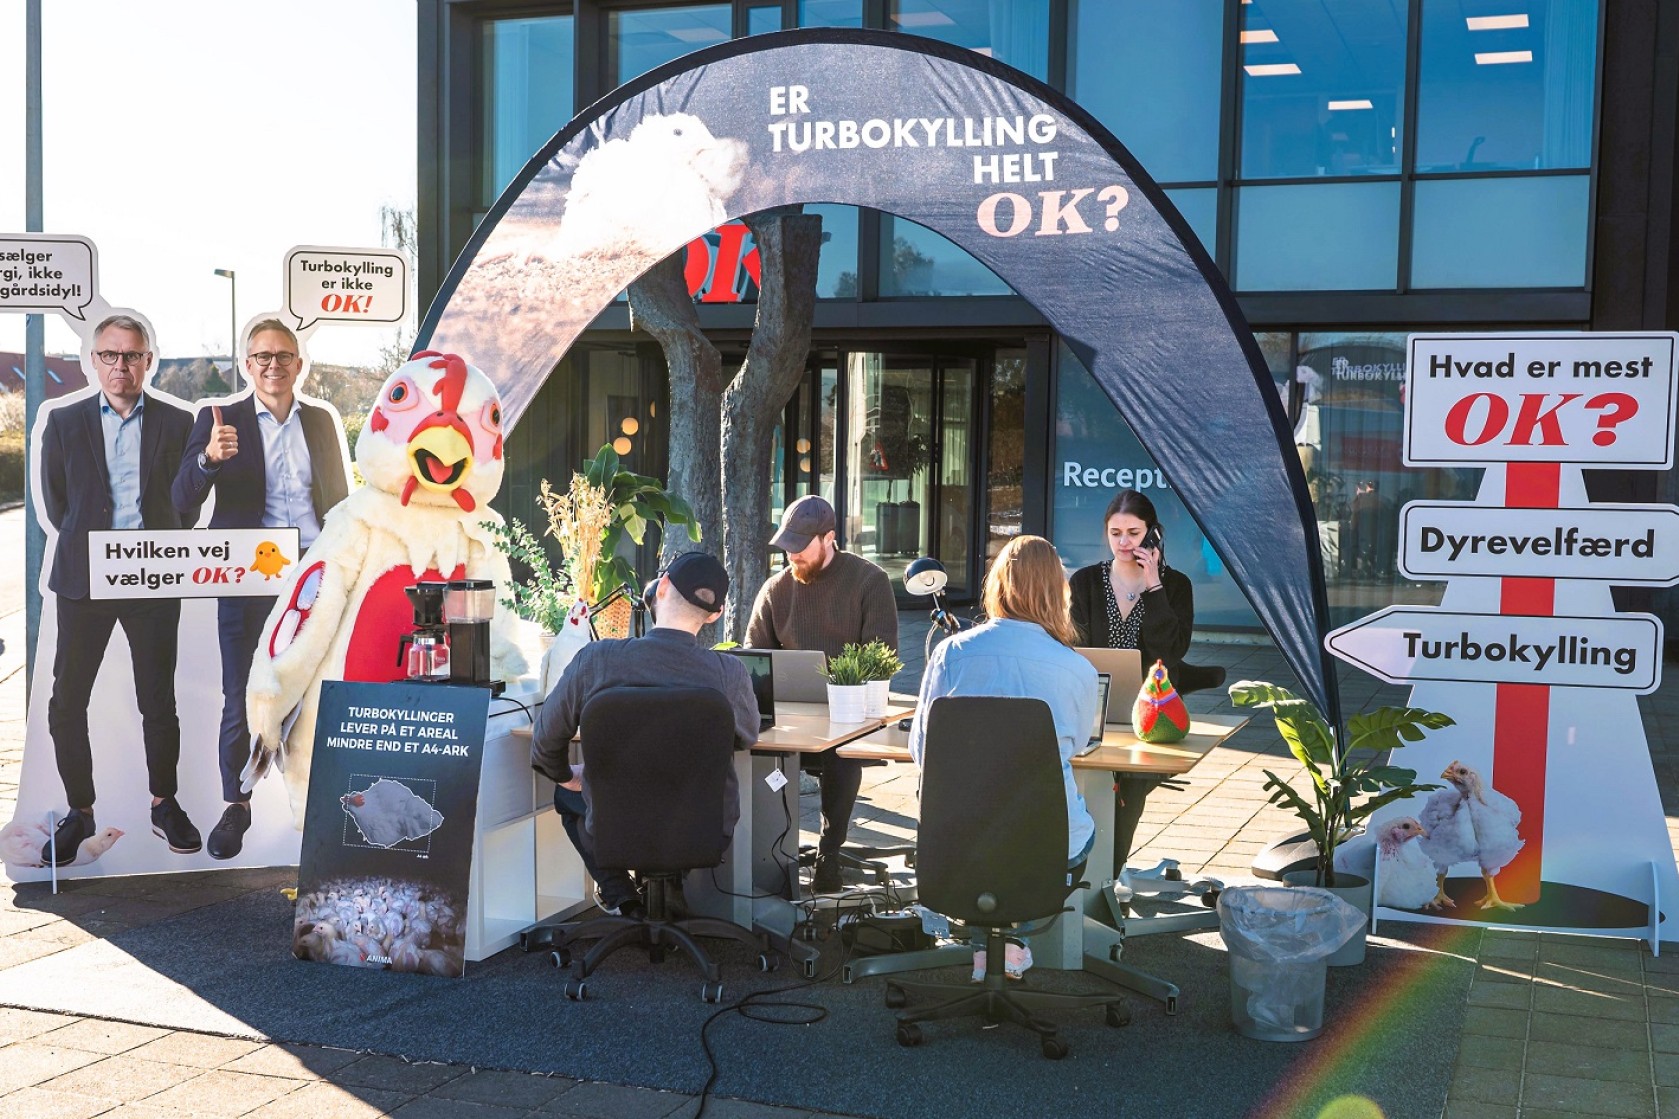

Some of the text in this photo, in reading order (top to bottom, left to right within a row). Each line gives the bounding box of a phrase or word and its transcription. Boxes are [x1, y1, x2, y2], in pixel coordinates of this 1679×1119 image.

[769, 85, 811, 116] ER
[767, 114, 1058, 153] TURBOKYLLING
[973, 152, 1059, 184] HELT
[976, 185, 1130, 238] OK?
[0, 248, 53, 265] sælger
[28, 266, 63, 279] ikke
[300, 260, 394, 278] Turbokylling
[0, 282, 82, 300] gårdsidyl!
[321, 277, 373, 290] er ikke
[321, 293, 374, 314] OK!
[1429, 352, 1654, 379] Hvad er mest
[1444, 391, 1640, 447] OK?
[1063, 461, 1172, 493] Recept
[105, 541, 230, 561] Hvilken vej
[1420, 526, 1655, 562] Dyrevelfærd
[105, 566, 246, 590] vælger OK?
[1402, 631, 1637, 675] Turbokylling
[348, 706, 455, 724] TURBOKYLLINGER
[340, 721, 459, 740] LEVER PÅ ET AREAL
[326, 736, 470, 757] MINDRE END ET A4-ARK
[366, 954, 393, 965] ANIMA
